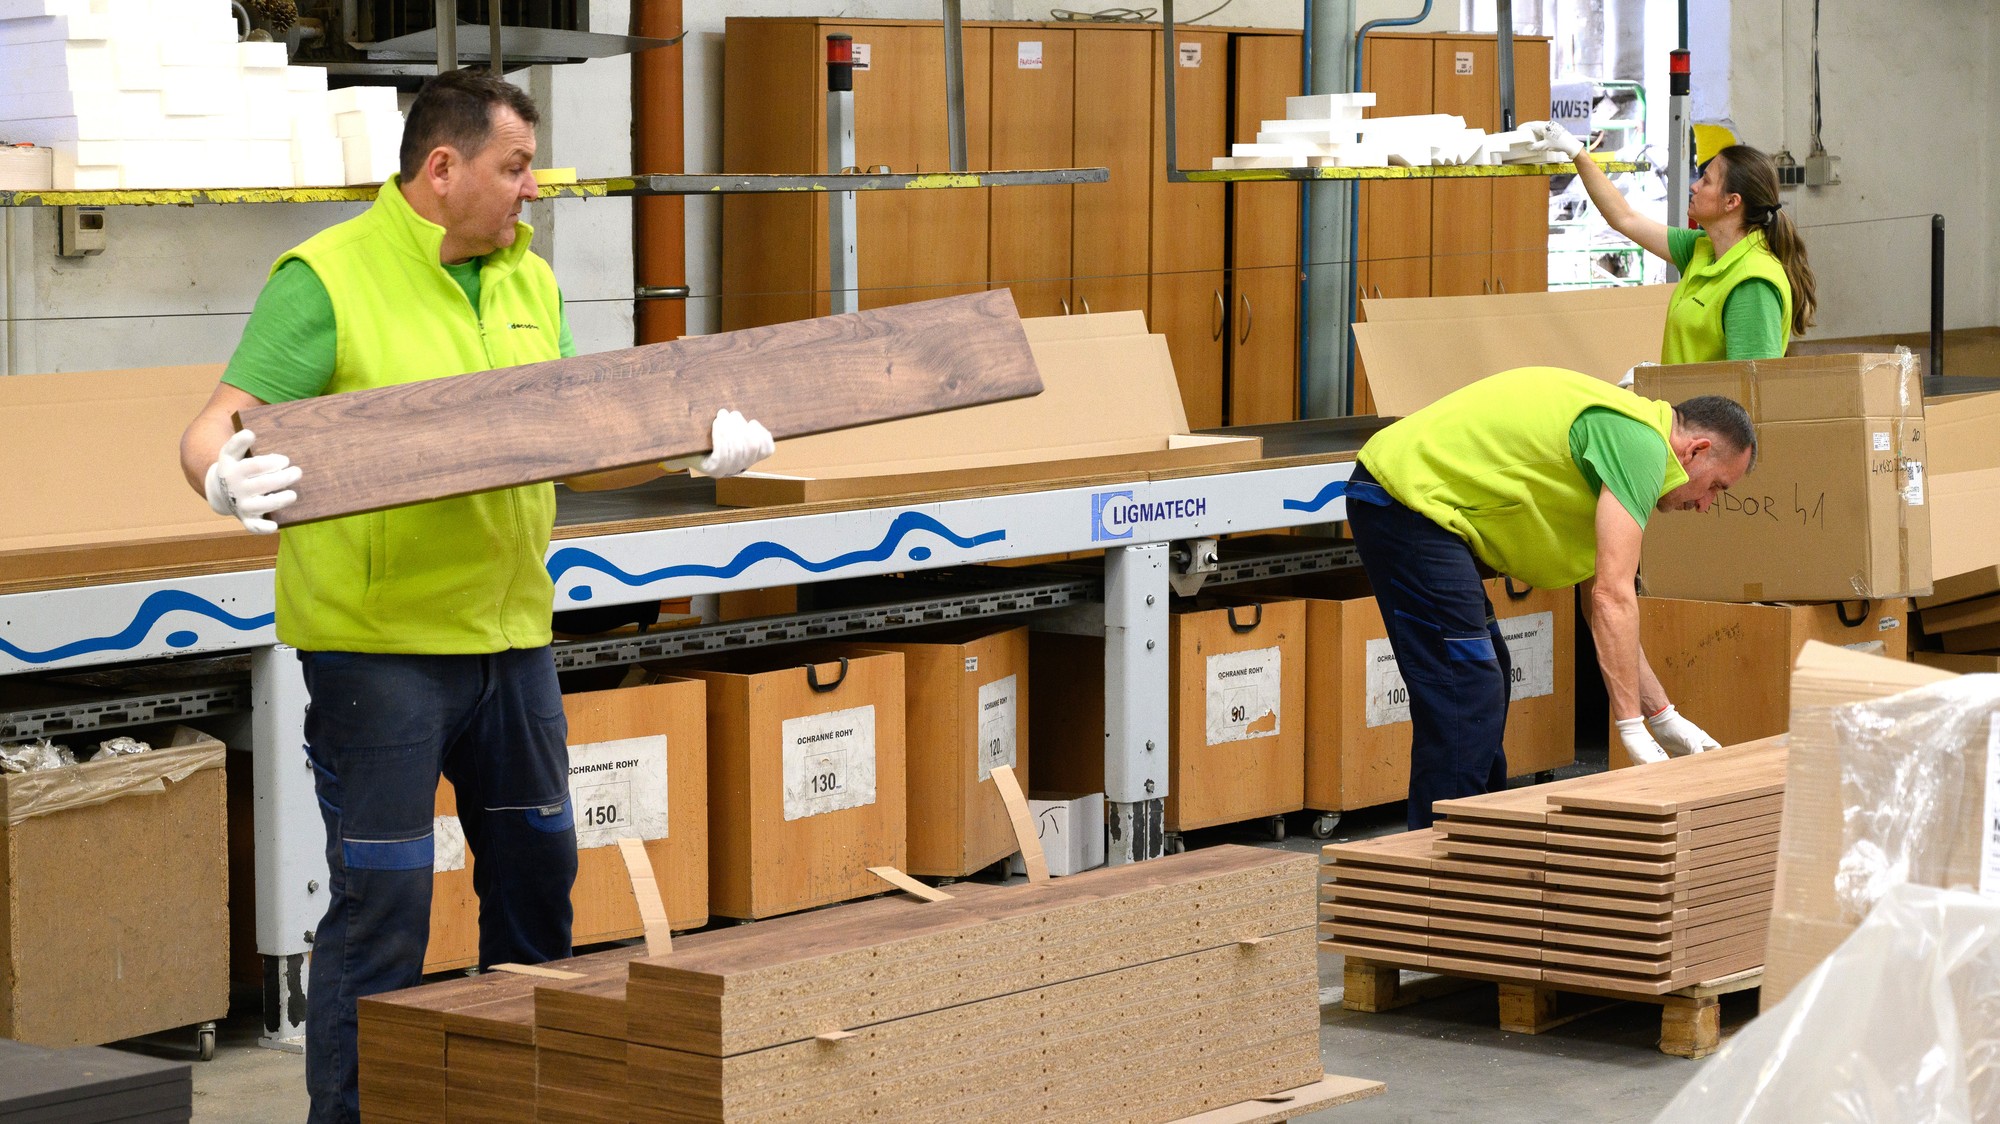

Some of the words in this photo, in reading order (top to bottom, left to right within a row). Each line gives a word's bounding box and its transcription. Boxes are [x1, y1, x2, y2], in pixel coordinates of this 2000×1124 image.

[1551, 100, 1590, 119] KW53
[1113, 497, 1206, 525] LIGMATECH
[1705, 491, 1778, 521] ADOR
[1524, 630, 1537, 639] ROHY
[1377, 654, 1396, 663] OCHRA
[1248, 666, 1264, 675] ROHY
[1000, 696, 1008, 705] ROHY
[1387, 688, 1406, 705] 100
[1231, 705, 1245, 722] 90
[797, 731, 834, 745] OCHRANNÉ
[835, 728, 854, 738] ROHY
[990, 737, 1001, 757] 120
[568, 760, 614, 775] OCHRANNÉ
[615, 759, 640, 769] ROHY
[811, 772, 836, 793] 130
[585, 804, 617, 826] 150
